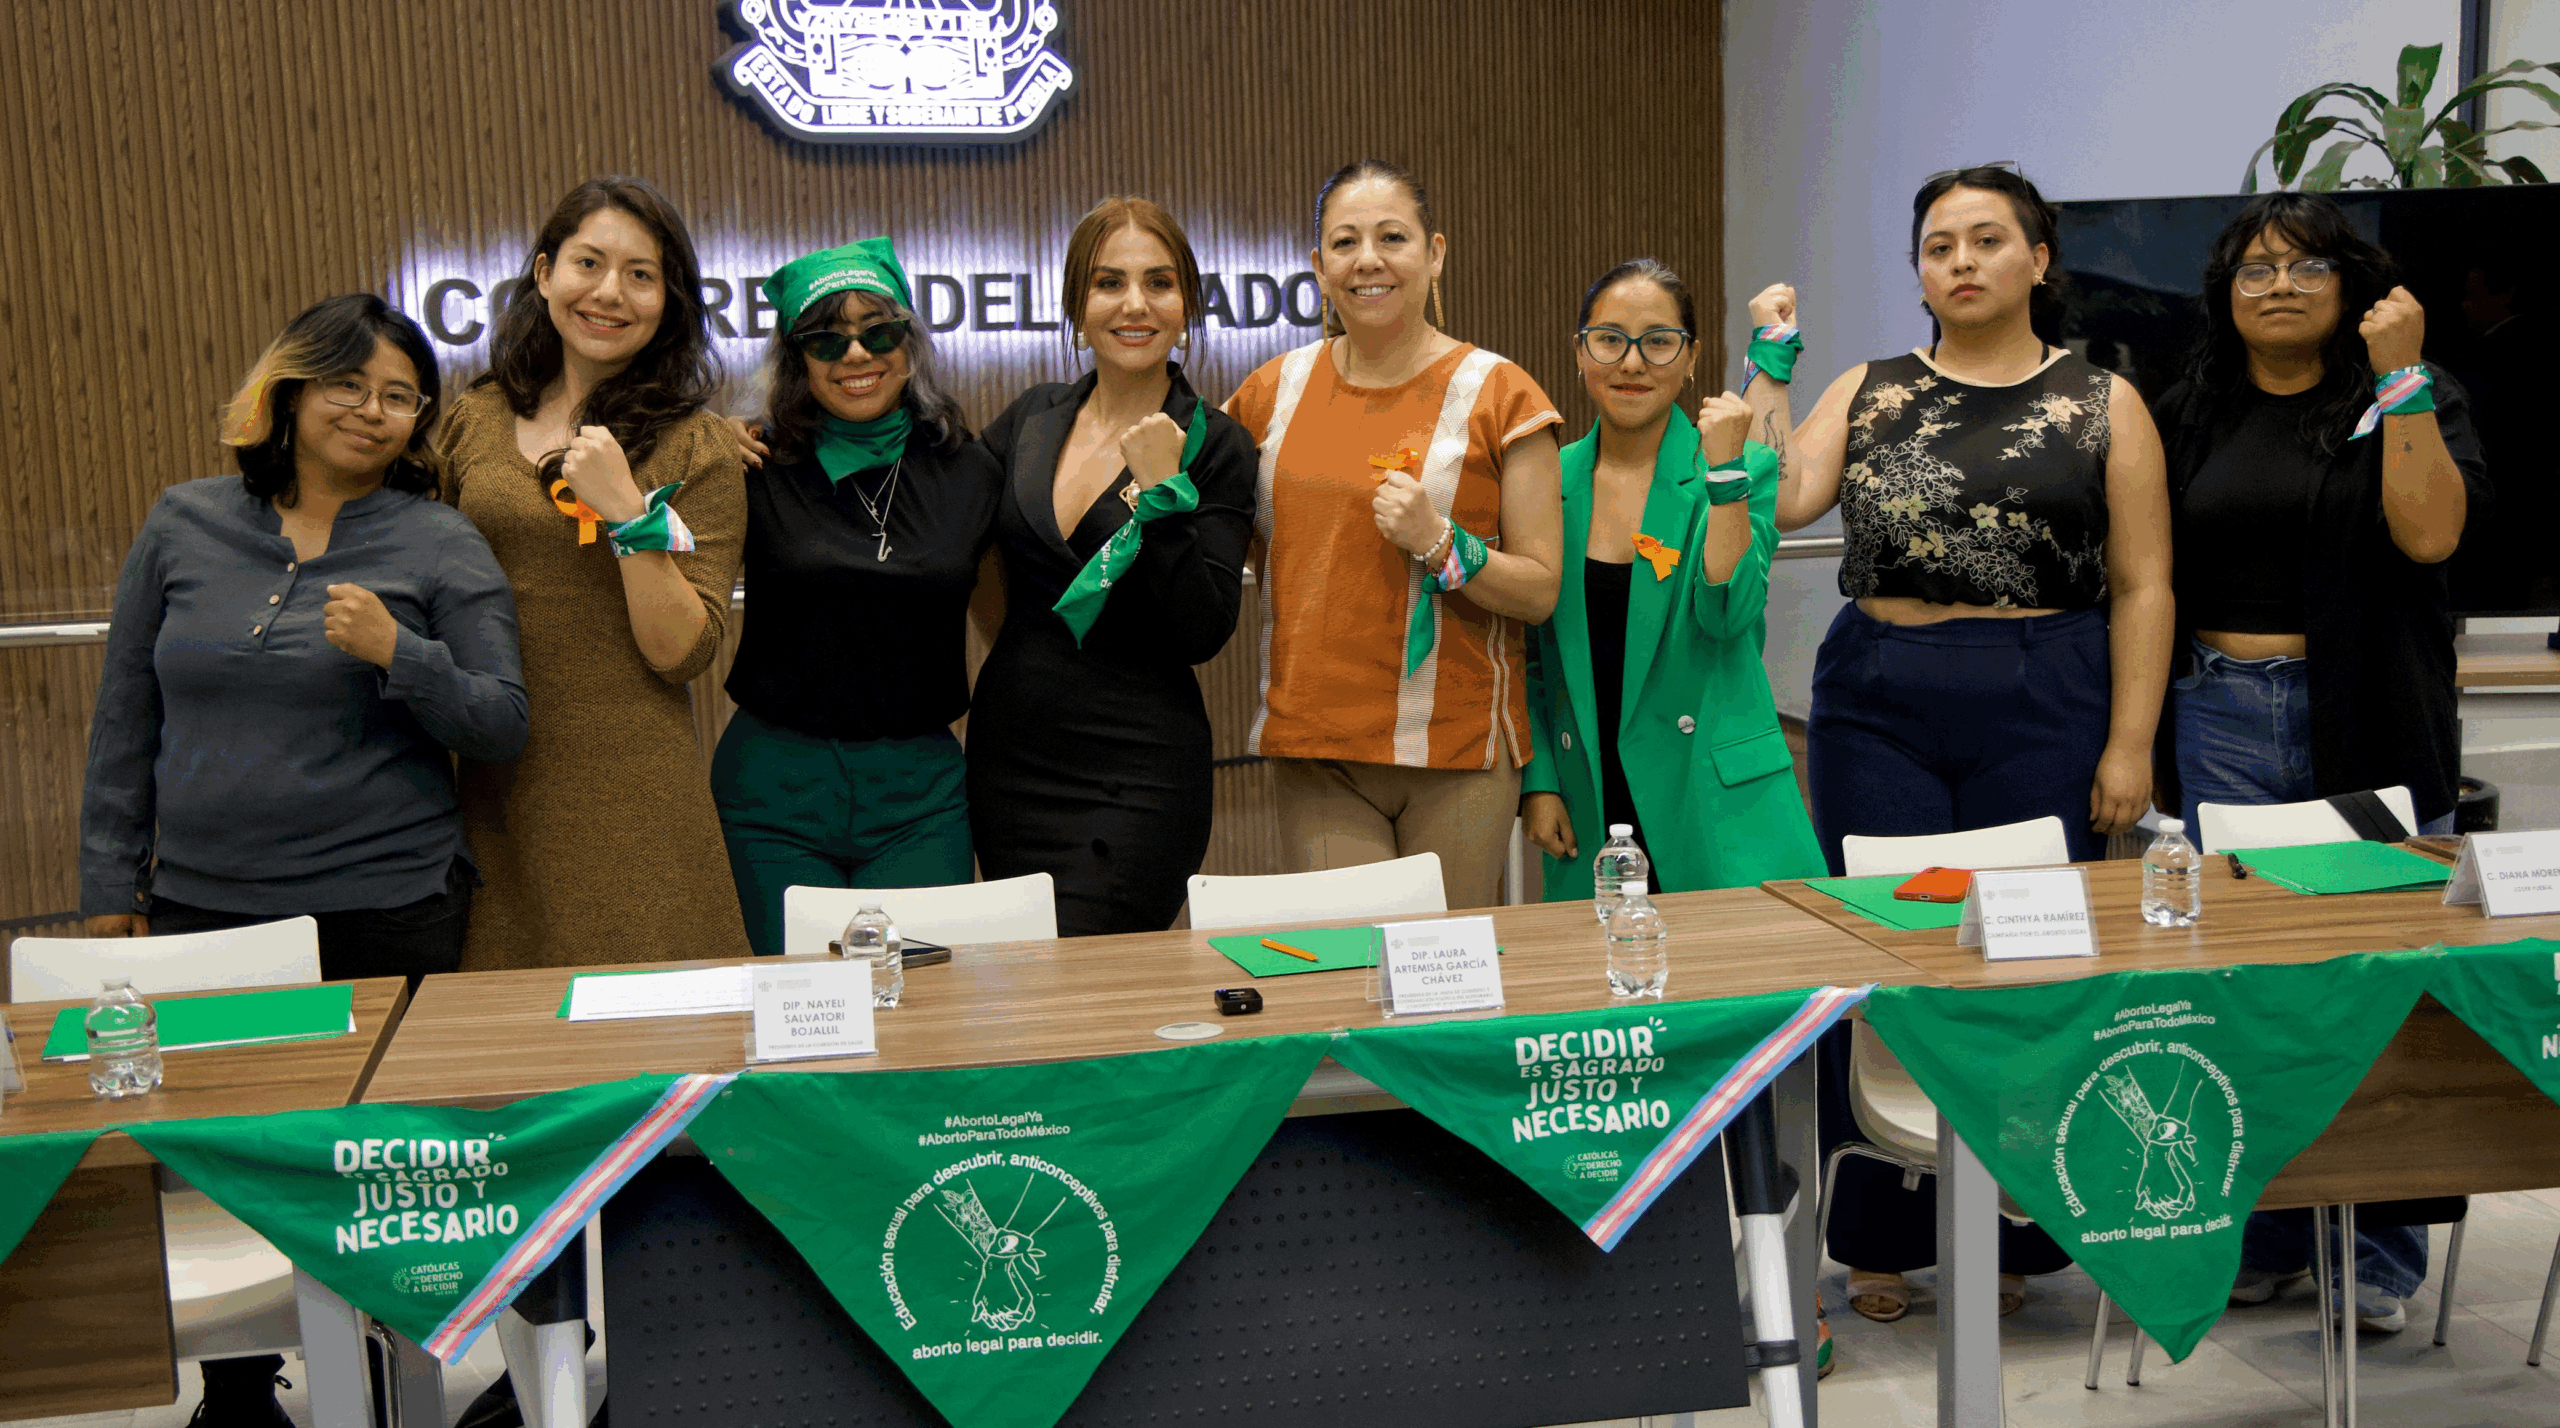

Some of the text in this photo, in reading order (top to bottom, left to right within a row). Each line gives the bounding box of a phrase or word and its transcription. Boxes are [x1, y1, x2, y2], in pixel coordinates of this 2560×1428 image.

[749, 53, 816, 124] ESTADO
[914, 273, 1060, 333] DEL
[1200, 272, 1322, 329] ADO
[2498, 870, 2529, 880] DIANA
[1983, 910, 2086, 925] C. CINTHYA RAMÍREZ
[1411, 948, 1467, 960] DIP. LAURA
[1394, 958, 1488, 974] ARTEMISA GARCÍA
[1421, 973, 1464, 985] CHÁVEZ
[783, 998, 846, 1011] DIP. NAYELI
[2114, 1000, 2192, 1022] #AbortoLegalYa
[784, 1012, 845, 1024] SALVATORI
[2093, 1013, 2216, 1041] #AbortoParaTodoMéxico
[791, 1025, 840, 1037] BOJALLIL
[1515, 1025, 1655, 1067] DECIDIR
[2099, 1039, 2164, 1072] descubrir,
[1520, 1056, 1665, 1080] ES SAGRADO
[2166, 1041, 2239, 1106] anticonceptivos
[1525, 1076, 1643, 1111] JUSTO Y
[2075, 1070, 2100, 1101] para
[944, 1111, 1043, 1129] #AbortoLegalYa
[1511, 1098, 1671, 1143] NECESARIO
[2055, 1099, 2079, 1144] sexual
[2227, 1106, 2244, 1138] para
[918, 1124, 1071, 1146] #AbortoParaTodoMéxico
[334, 1138, 491, 1173] DECIDIR
[1577, 1149, 1619, 1161] CATÓLICAS
[1586, 1158, 1623, 1170] DERECHO
[375, 1162, 509, 1182] SAGRADO
[1579, 1168, 1619, 1179] A DECIDIR
[2052, 1146, 2087, 1218] Educación
[353, 1180, 486, 1218] JUSTO Y
[335, 1203, 519, 1255] NECESARIO
[2081, 1229, 2127, 1243] aborto
[2130, 1224, 2166, 1240] legal
[2170, 1223, 2202, 1238] para
[879, 1150, 1121, 1331] Educación sexual para descubrir, anticonceptivos para disfrutar,
[410, 1261, 460, 1275] CATÓLICAS
[420, 1271, 463, 1284] DERECHO
[413, 1281, 458, 1293] A DECIDIR
[912, 1330, 1103, 1360] aborto legal para decidir.
